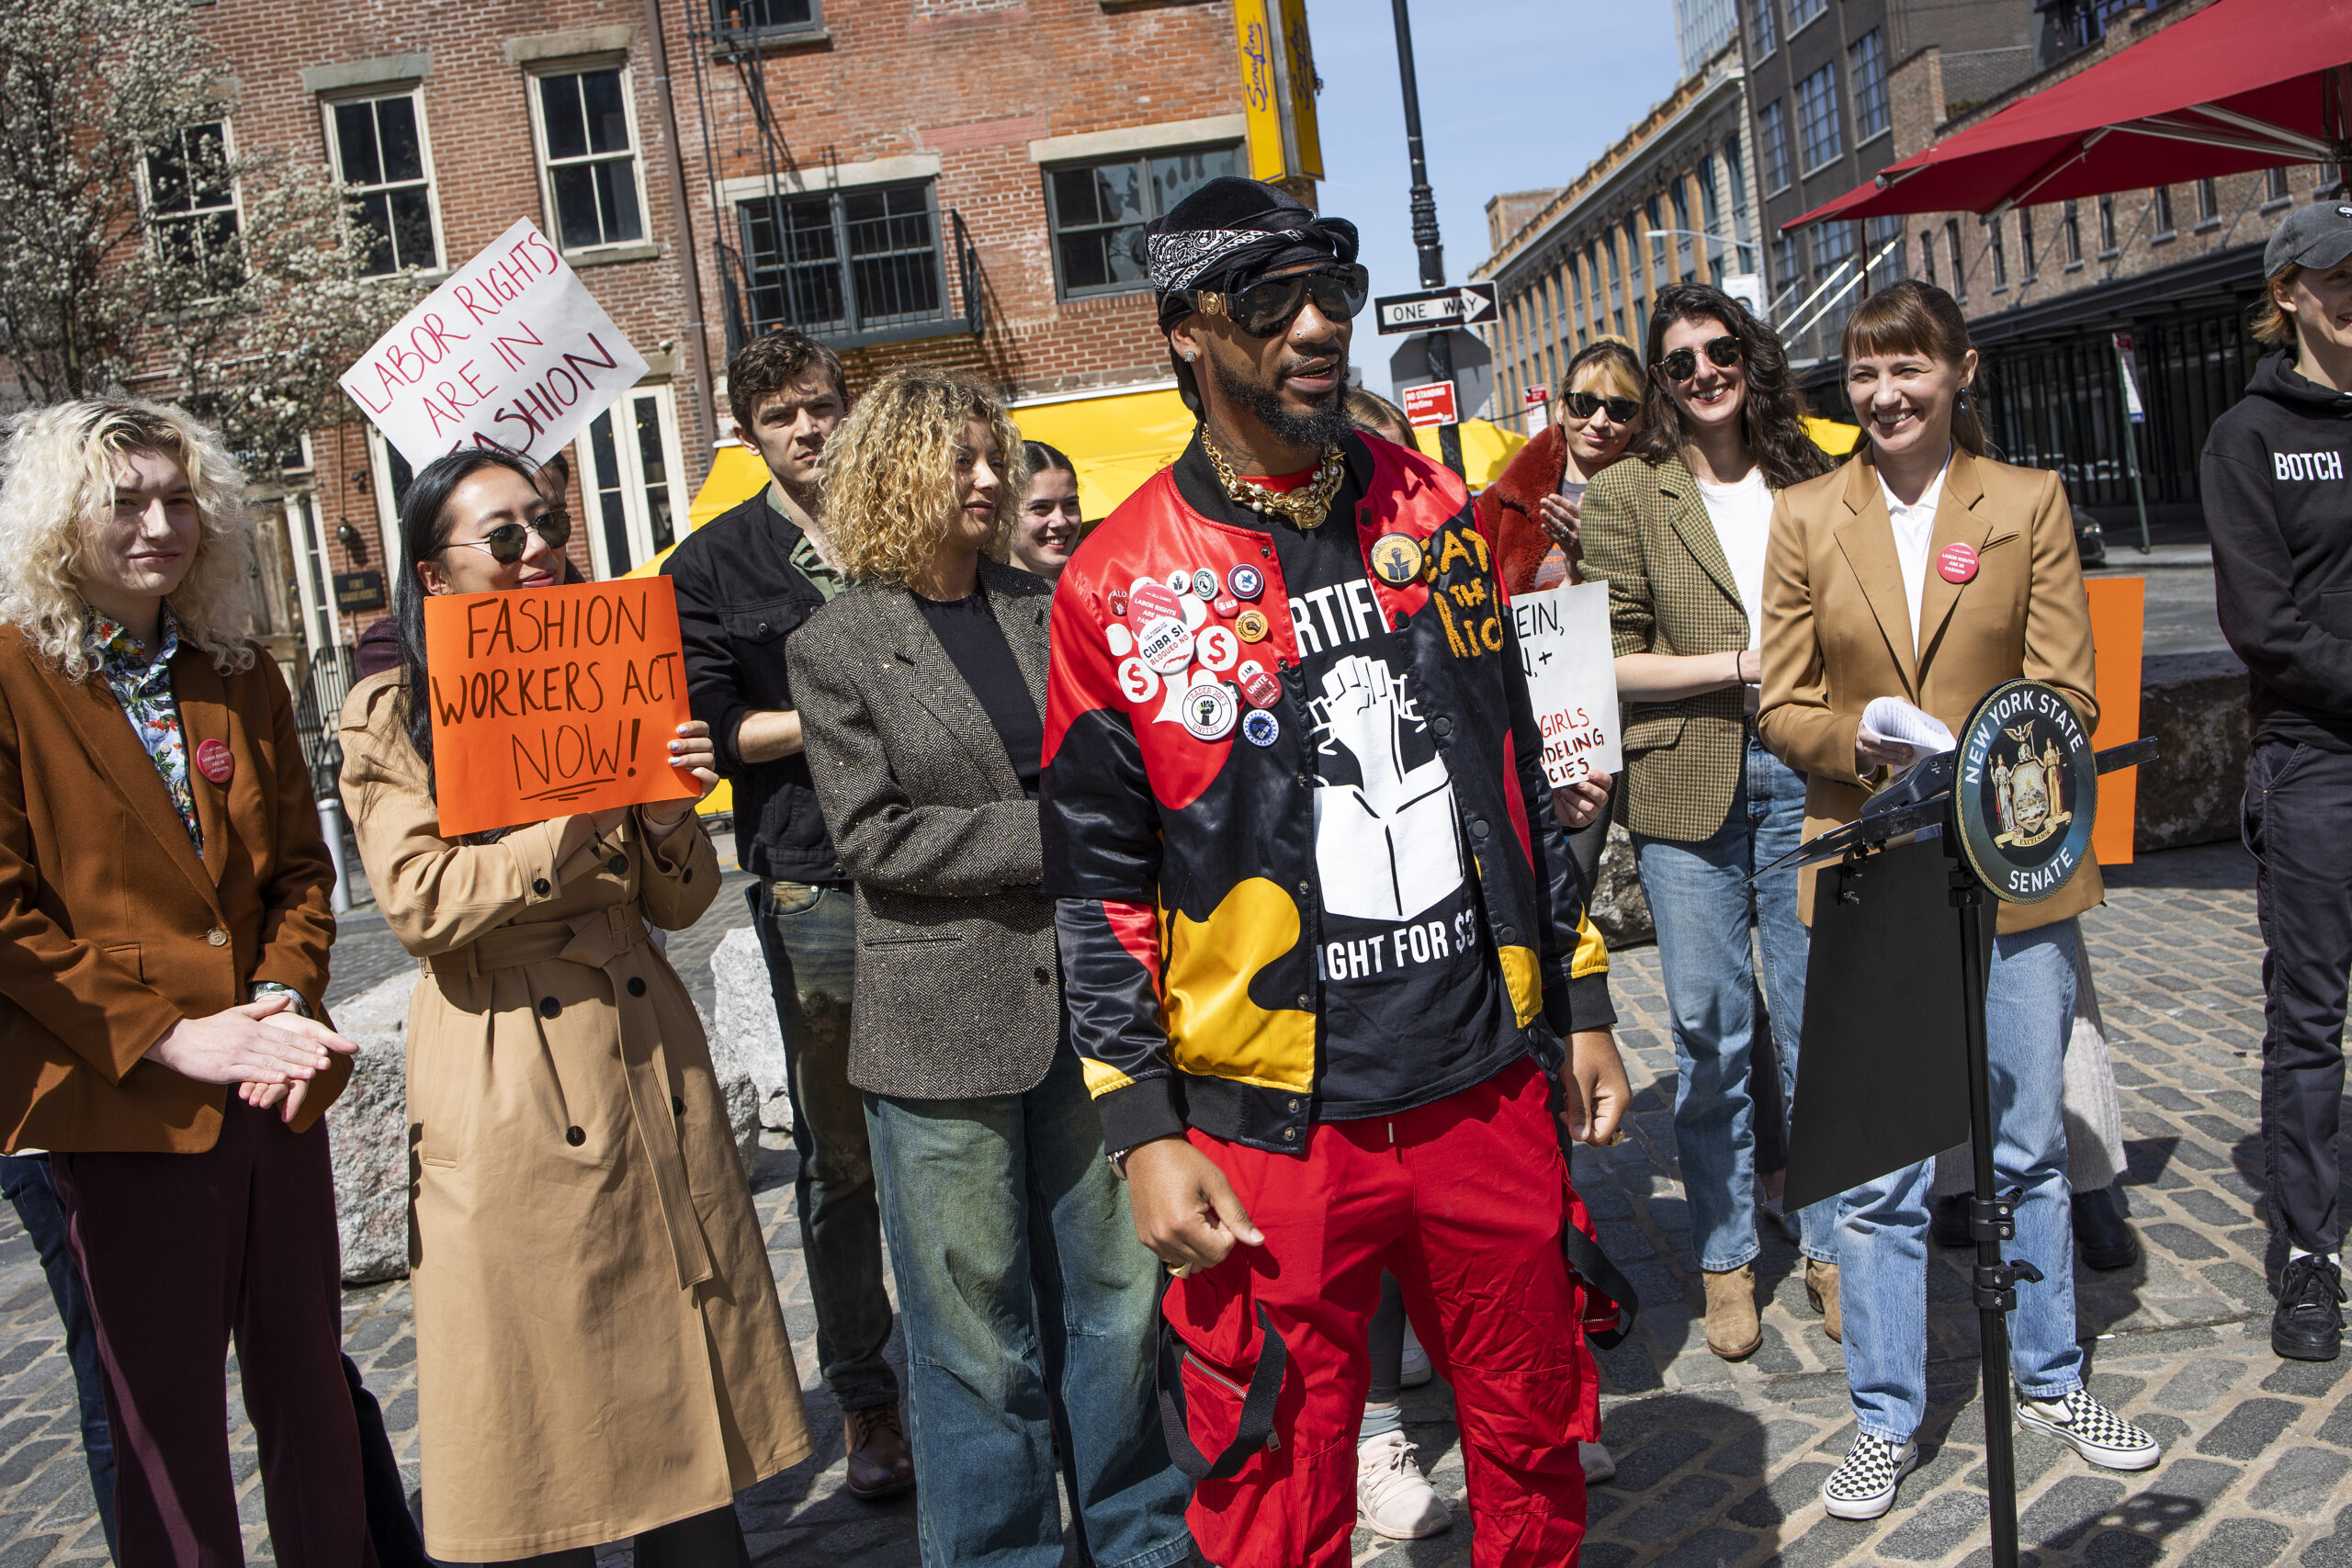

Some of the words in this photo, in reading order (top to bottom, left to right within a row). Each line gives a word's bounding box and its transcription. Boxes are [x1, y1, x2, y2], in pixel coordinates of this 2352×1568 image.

[350, 313, 471, 413] LABOR
[453, 231, 559, 326] RIGHTS
[1393, 304, 1428, 321] ONE
[1442, 297, 1477, 315] WAY
[423, 359, 499, 438] ARE
[491, 321, 544, 373] IN
[1406, 392, 1416, 401] NO
[1416, 387, 1446, 400] STANDING
[447, 332, 617, 459] ASHION
[2274, 451, 2344, 481] BOTCH
[1945, 566, 1965, 574] FASHION
[1113, 590, 1127, 598] ALU
[1135, 598, 1154, 609] LABOR
[1154, 604, 1177, 616] RIGHTS
[1449, 578, 1487, 607] THE
[468, 591, 647, 659] FASHION
[1143, 610, 1155, 619] ARE
[1433, 581, 1503, 658] RIC
[1143, 635, 1171, 659] CUBA
[1171, 625, 1184, 637] SI
[1149, 642, 1179, 665] BLOQUEO
[1179, 634, 1189, 644] NO
[1245, 665, 1255, 674] AM
[1247, 674, 1269, 694] UNITE
[432, 661, 604, 728] WORKERS
[622, 651, 678, 705] ACT
[1186, 687, 1212, 702] TRADER
[1213, 690, 1228, 706] JOE'S
[1254, 681, 1275, 701] HERE!
[1260, 692, 1274, 705] LOCAL
[1193, 723, 1219, 733] UNITED
[1540, 707, 1589, 739] GIRLS
[1964, 724, 1992, 784] NEW
[1988, 691, 2034, 728] YORK
[2038, 694, 2085, 753] STATE
[511, 718, 641, 790] NOW!
[1548, 757, 1589, 784] CIES
[2019, 829, 2051, 846] EXCELSIOR
[2008, 846, 2074, 893] SENATE
[1316, 934, 1385, 981] IGHT
[1393, 920, 1449, 967] FOR
[1454, 907, 1476, 954] $3
